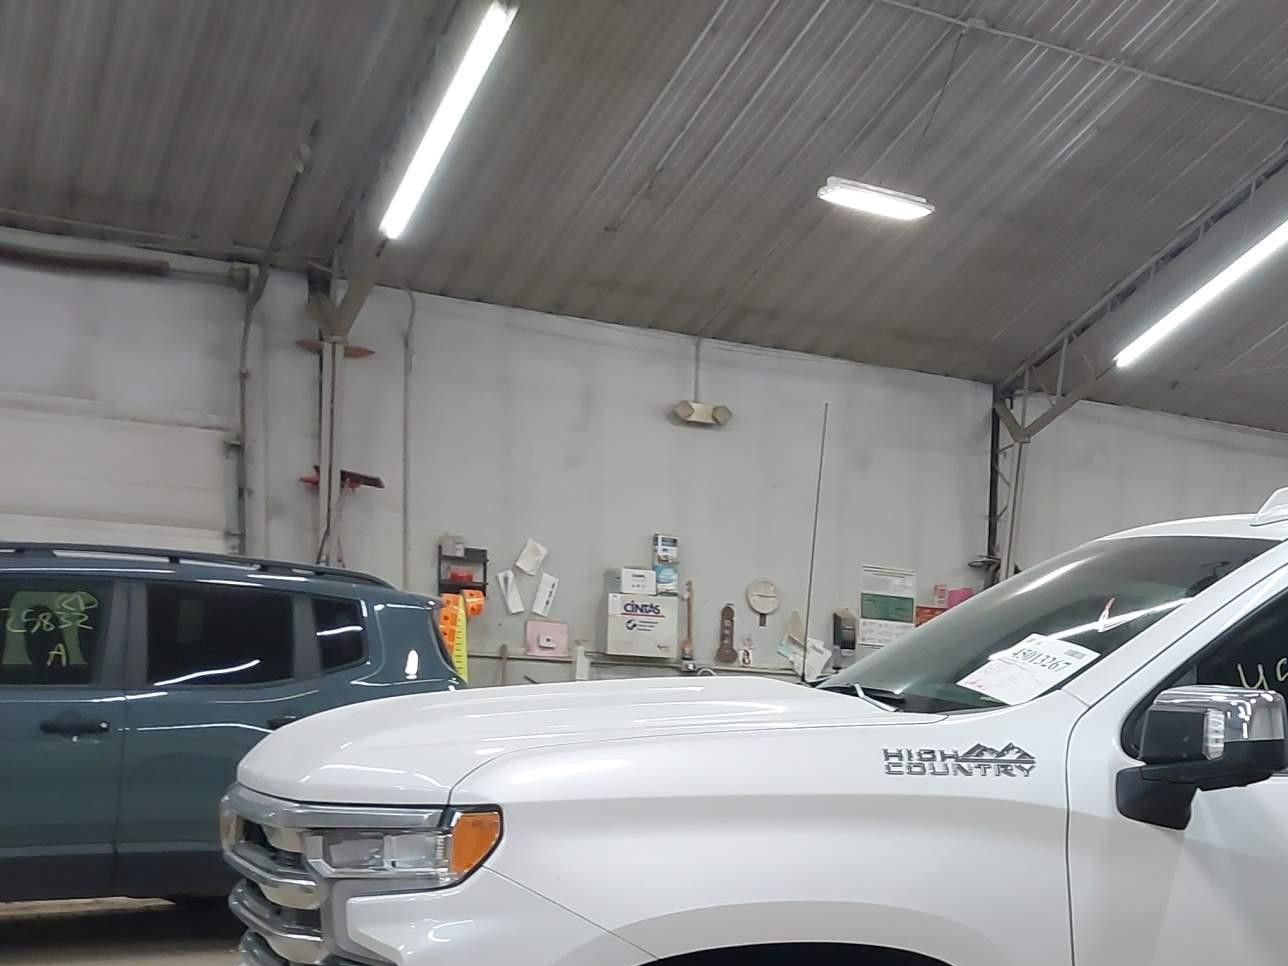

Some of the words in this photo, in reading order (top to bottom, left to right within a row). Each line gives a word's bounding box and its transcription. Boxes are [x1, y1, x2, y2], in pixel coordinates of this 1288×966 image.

[623, 600, 661, 615] CINTAS
[46, 643, 66, 667] A
[1011, 647, 1073, 673] 45013267
[882, 748, 959, 762] HIGH
[885, 762, 1036, 777] COUNTRY
